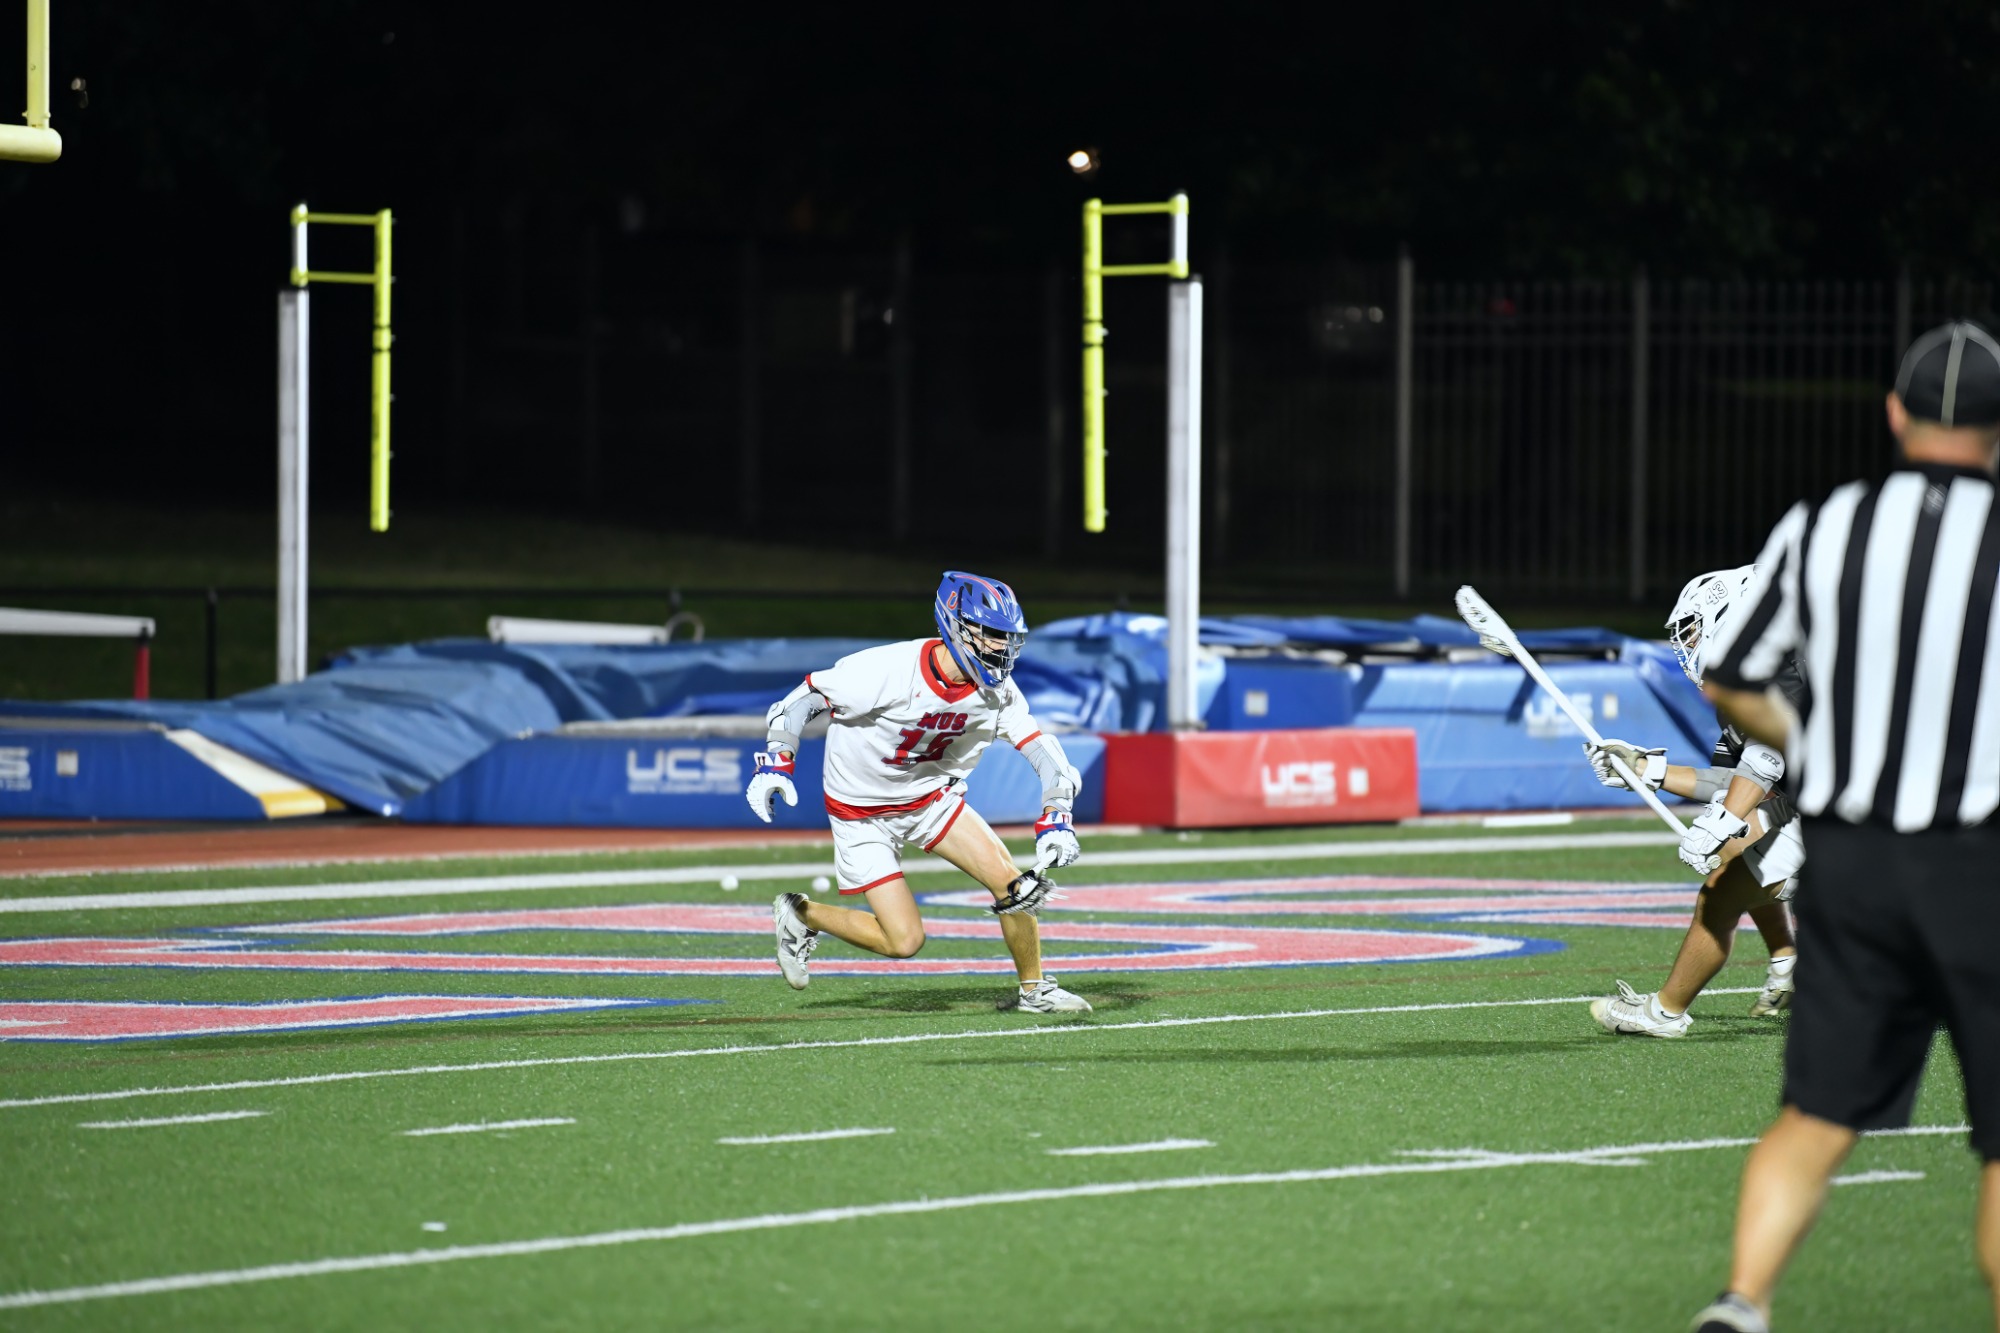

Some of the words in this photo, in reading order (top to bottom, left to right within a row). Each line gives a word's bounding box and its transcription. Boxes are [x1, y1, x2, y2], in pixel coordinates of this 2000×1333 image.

[1705, 580, 1728, 605] 43
[917, 711, 969, 731] MUS
[626, 747, 742, 780] UCS
[1760, 752, 1780, 768] STX
[1261, 761, 1336, 794] UCS
